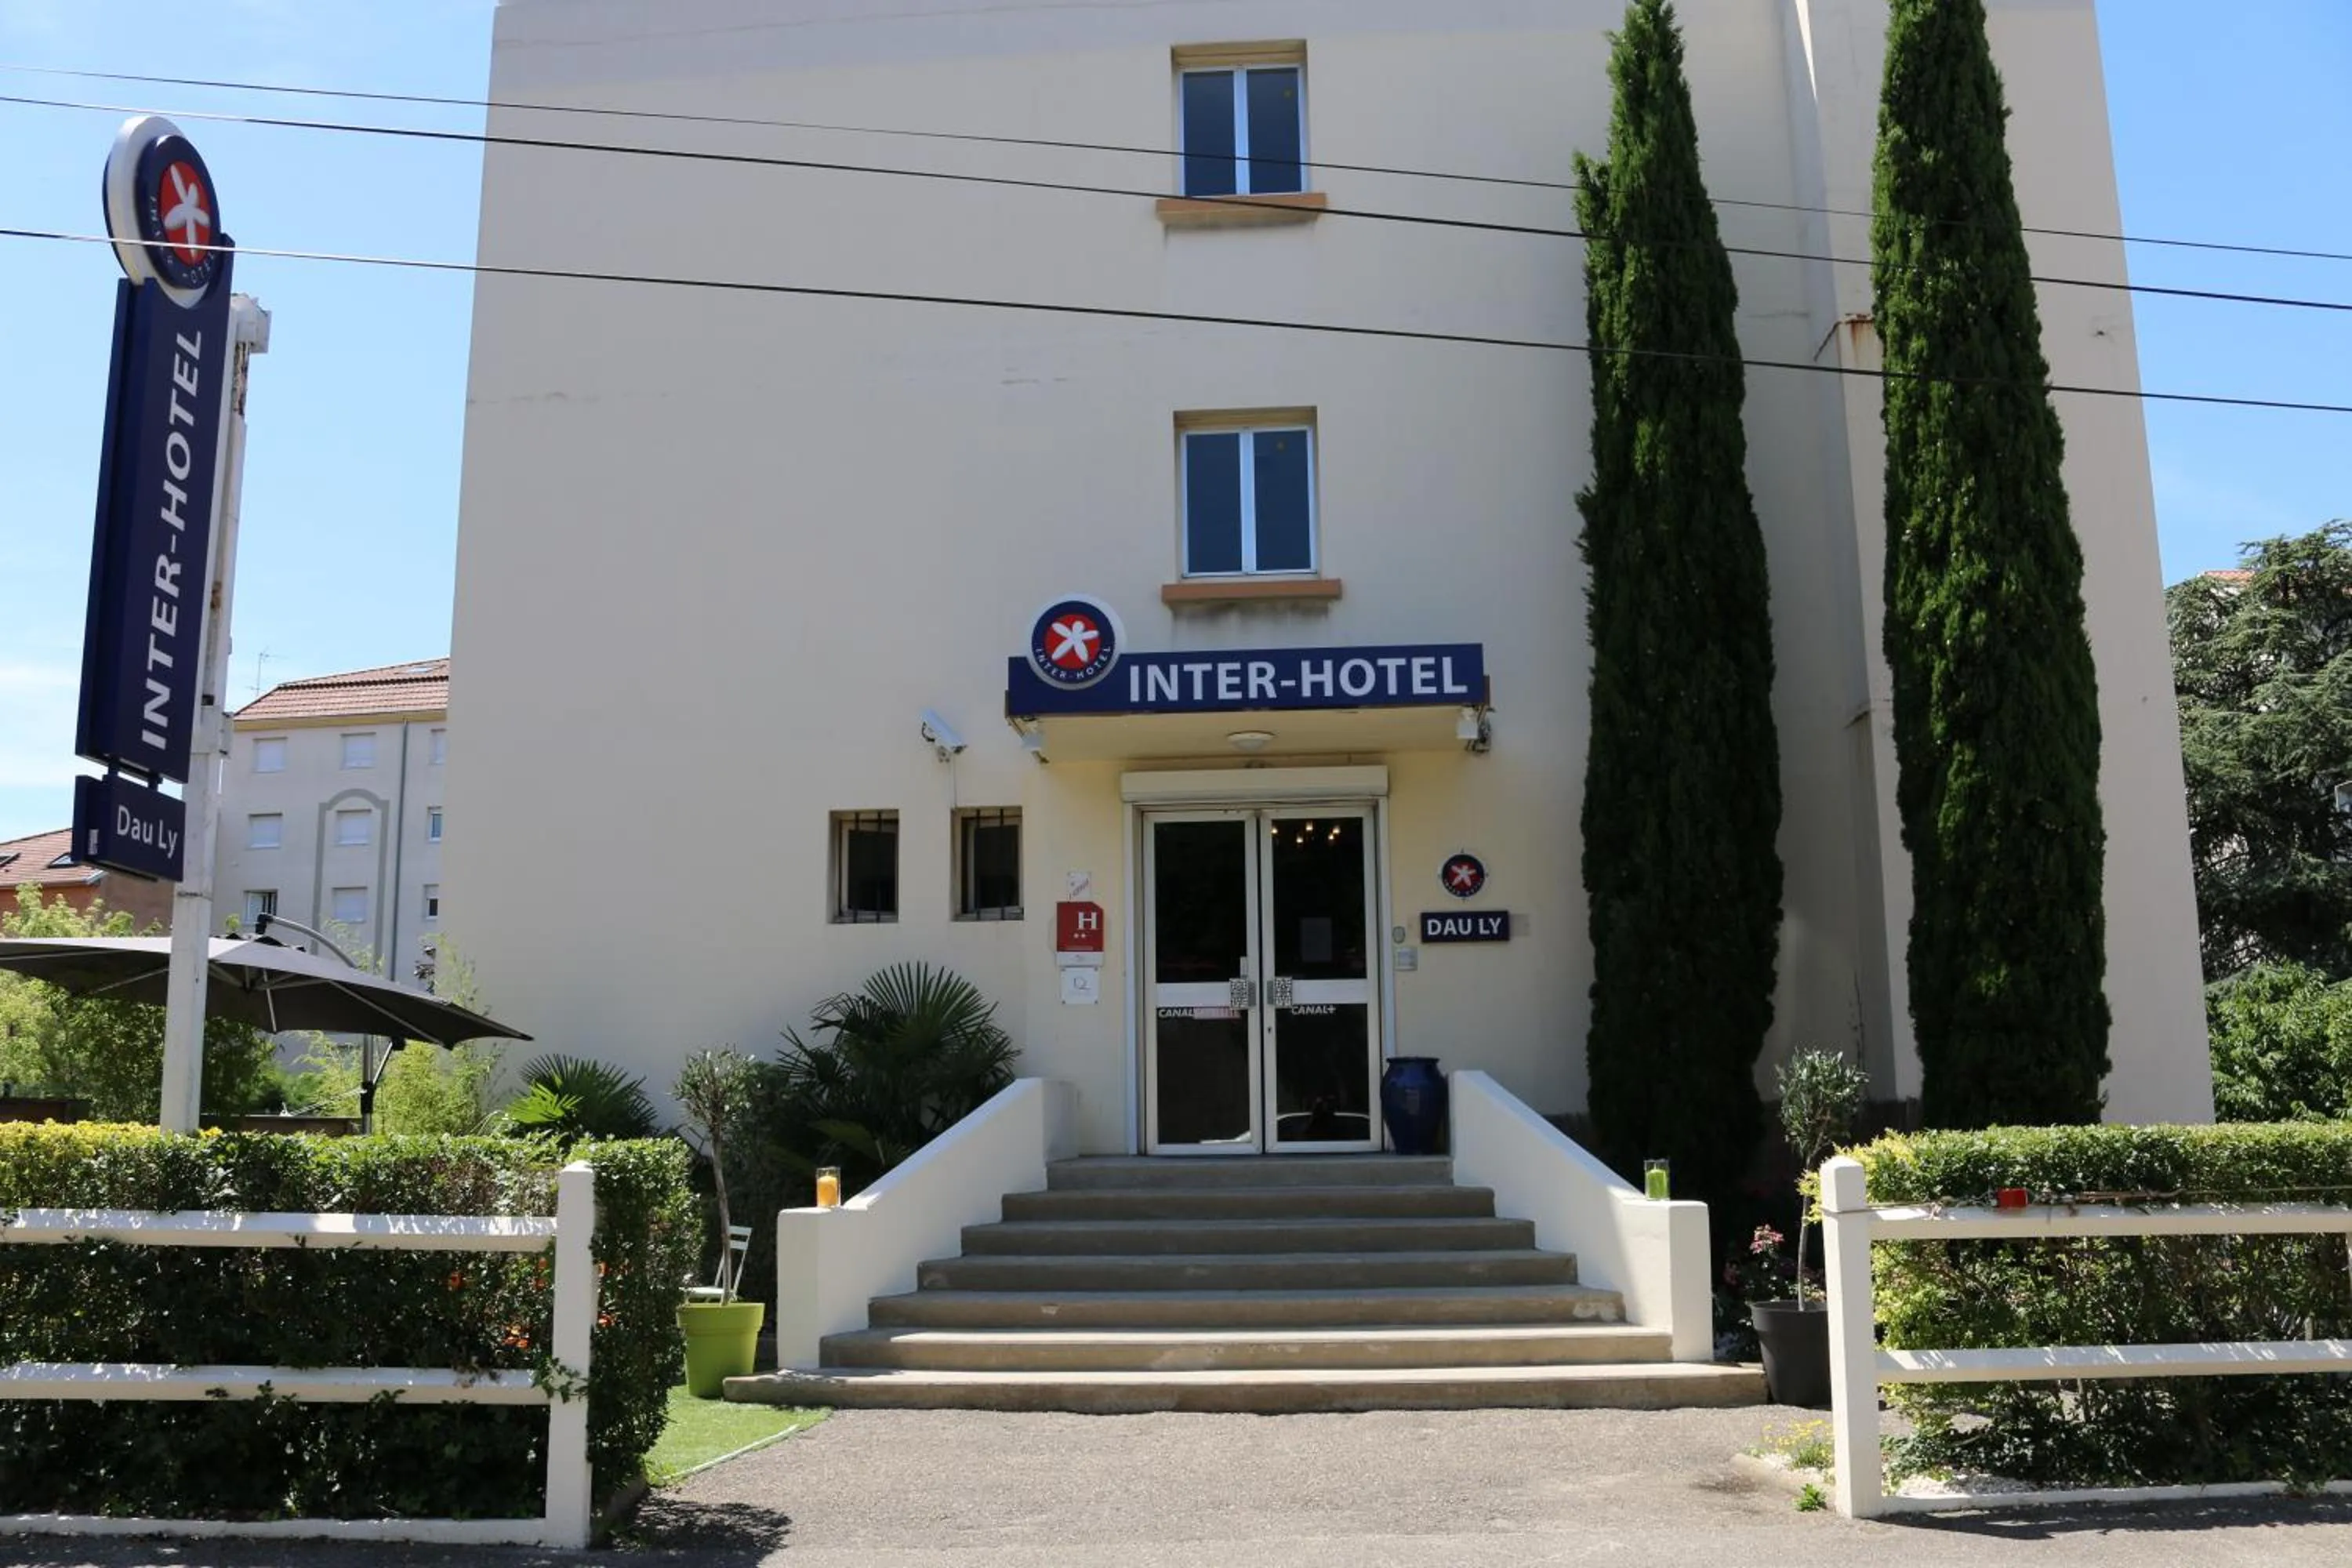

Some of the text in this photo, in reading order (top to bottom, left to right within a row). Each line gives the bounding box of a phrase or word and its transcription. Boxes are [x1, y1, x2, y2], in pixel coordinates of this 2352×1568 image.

[141, 330, 202, 750] INTER-HOTEL
[1130, 656, 1468, 702] INTER-HOTEL
[117, 804, 154, 846] Dau
[158, 819, 179, 859] Ly
[1077, 911, 1098, 931] H
[1427, 917, 1502, 935] DAU LY
